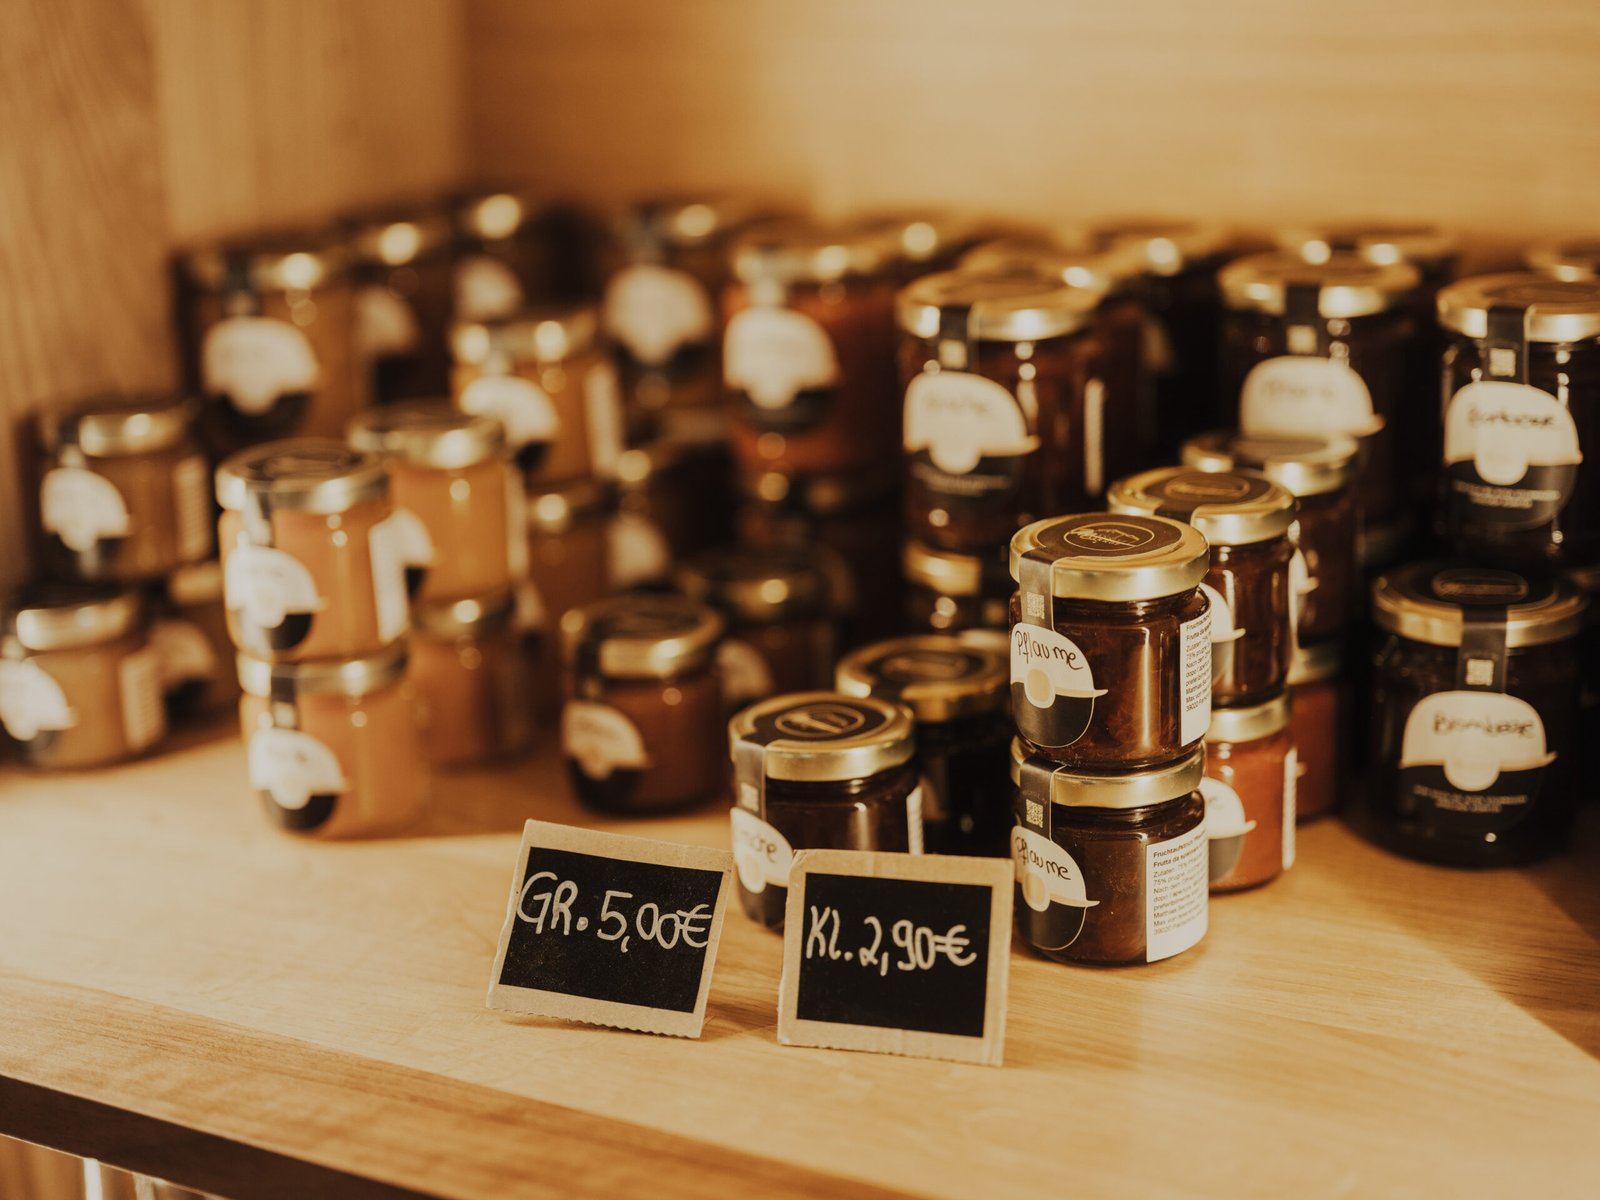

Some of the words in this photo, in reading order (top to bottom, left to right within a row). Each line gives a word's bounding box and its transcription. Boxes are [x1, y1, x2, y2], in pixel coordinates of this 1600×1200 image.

[516, 871, 589, 936] GR.
[596, 889, 713, 953] 5,00€
[858, 915, 977, 977] 2,90€
